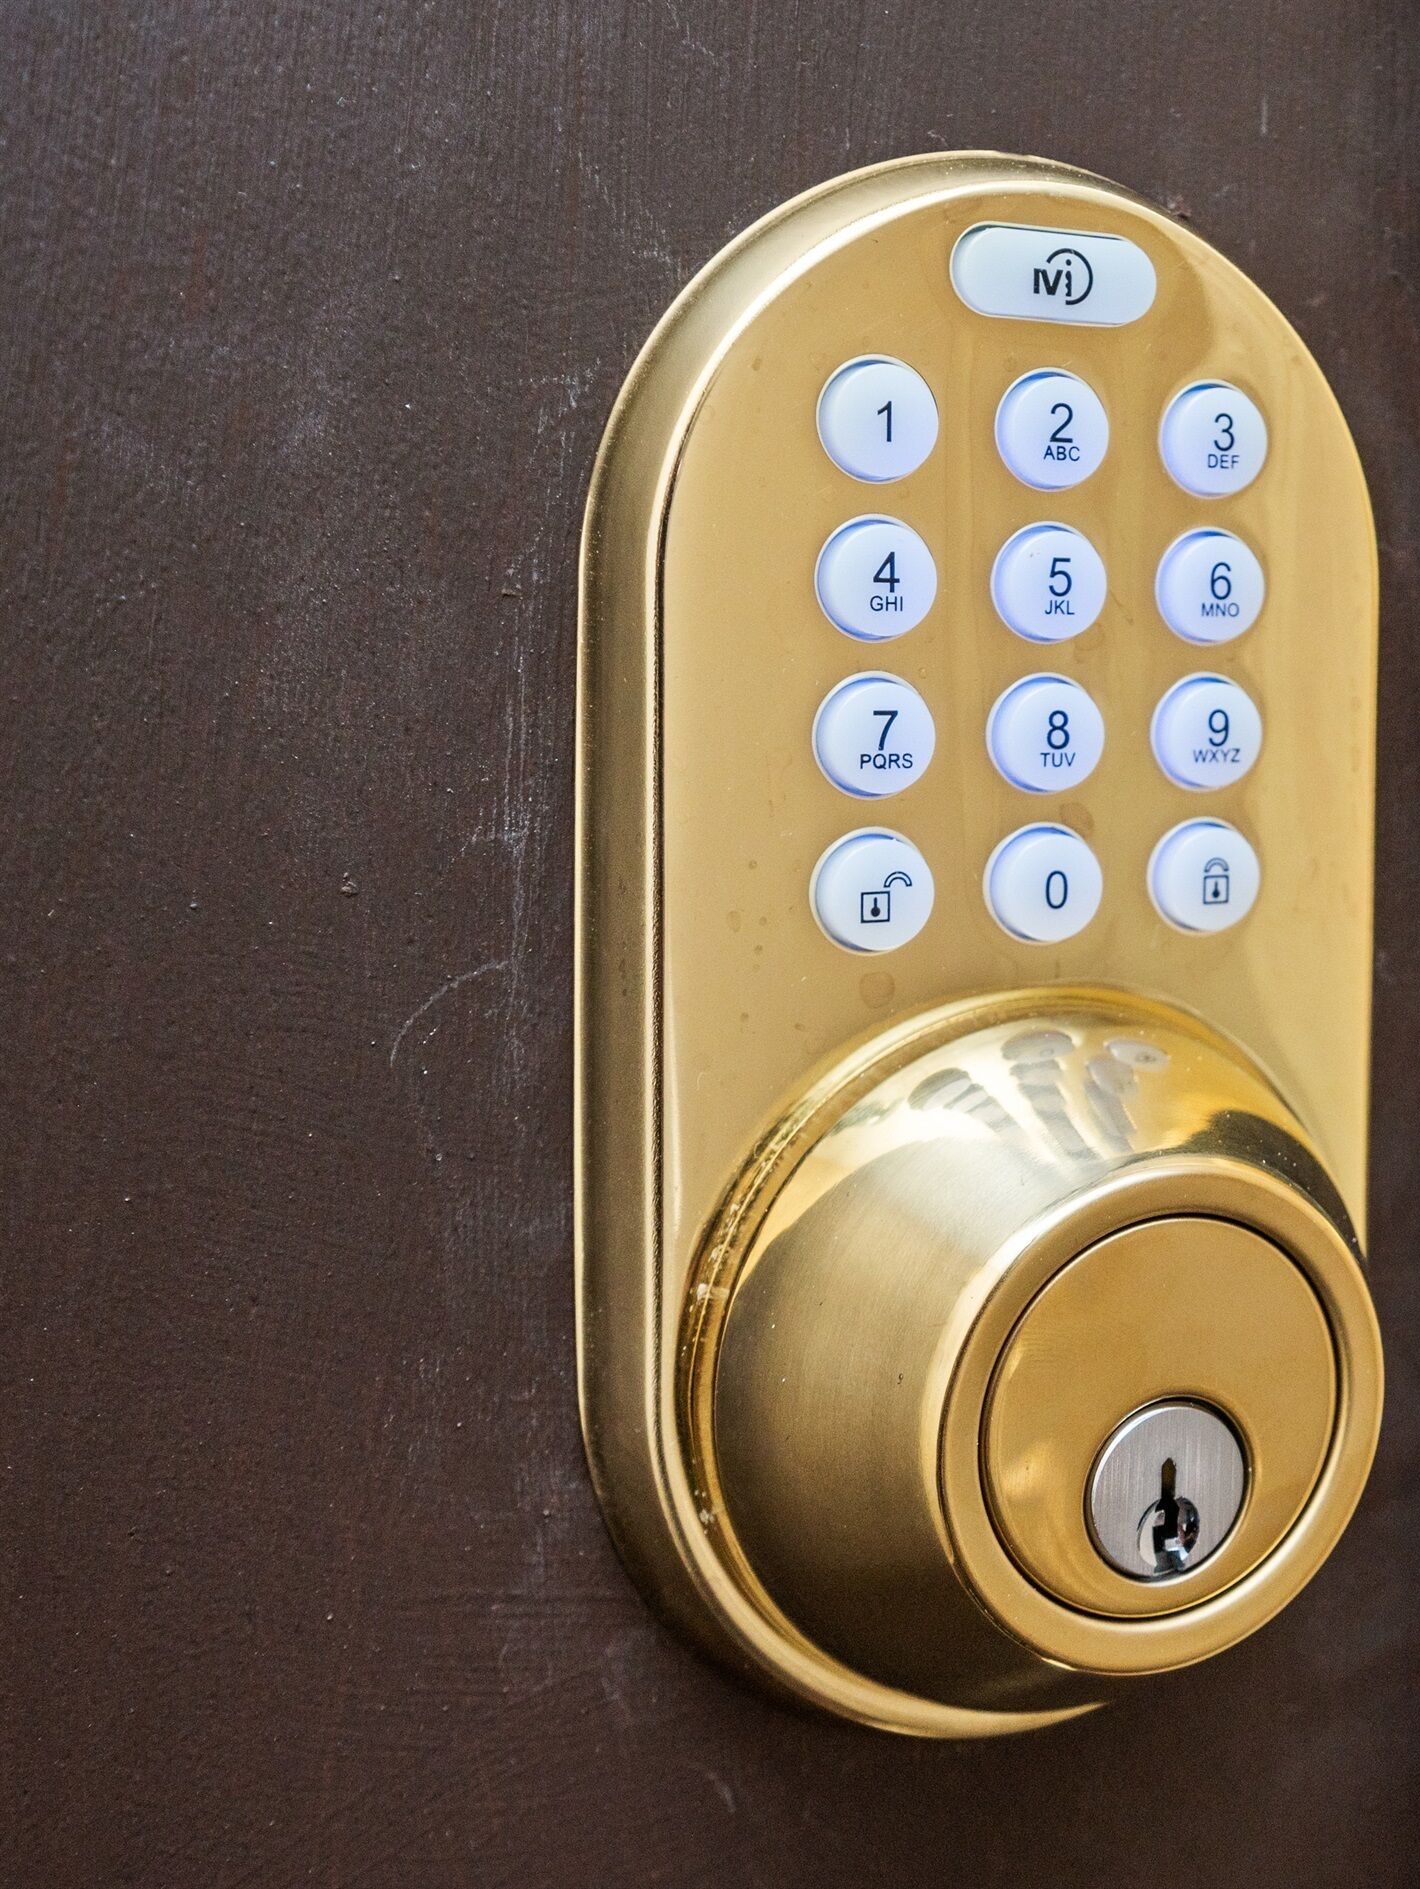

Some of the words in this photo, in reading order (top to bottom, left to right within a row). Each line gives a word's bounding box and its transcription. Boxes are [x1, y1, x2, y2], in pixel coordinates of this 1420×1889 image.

[877, 400, 892, 443] 1
[1049, 402, 1074, 444] 2
[1213, 412, 1235, 452] 3
[1043, 444, 1081, 462] ABC
[1207, 453, 1240, 470] DEF
[872, 551, 901, 594] 4
[1048, 557, 1073, 597] 5
[1210, 561, 1232, 601] 6
[869, 595, 904, 612] GHI
[1044, 599, 1075, 616] JKL
[1201, 602, 1240, 618] MNO
[872, 710, 899, 752] 7
[1046, 709, 1070, 751] 8
[1208, 708, 1230, 748] 9
[860, 752, 914, 770] PQRS
[1040, 752, 1076, 768] TUV
[1194, 748, 1241, 763] WXYZ
[1045, 870, 1069, 910] 0
